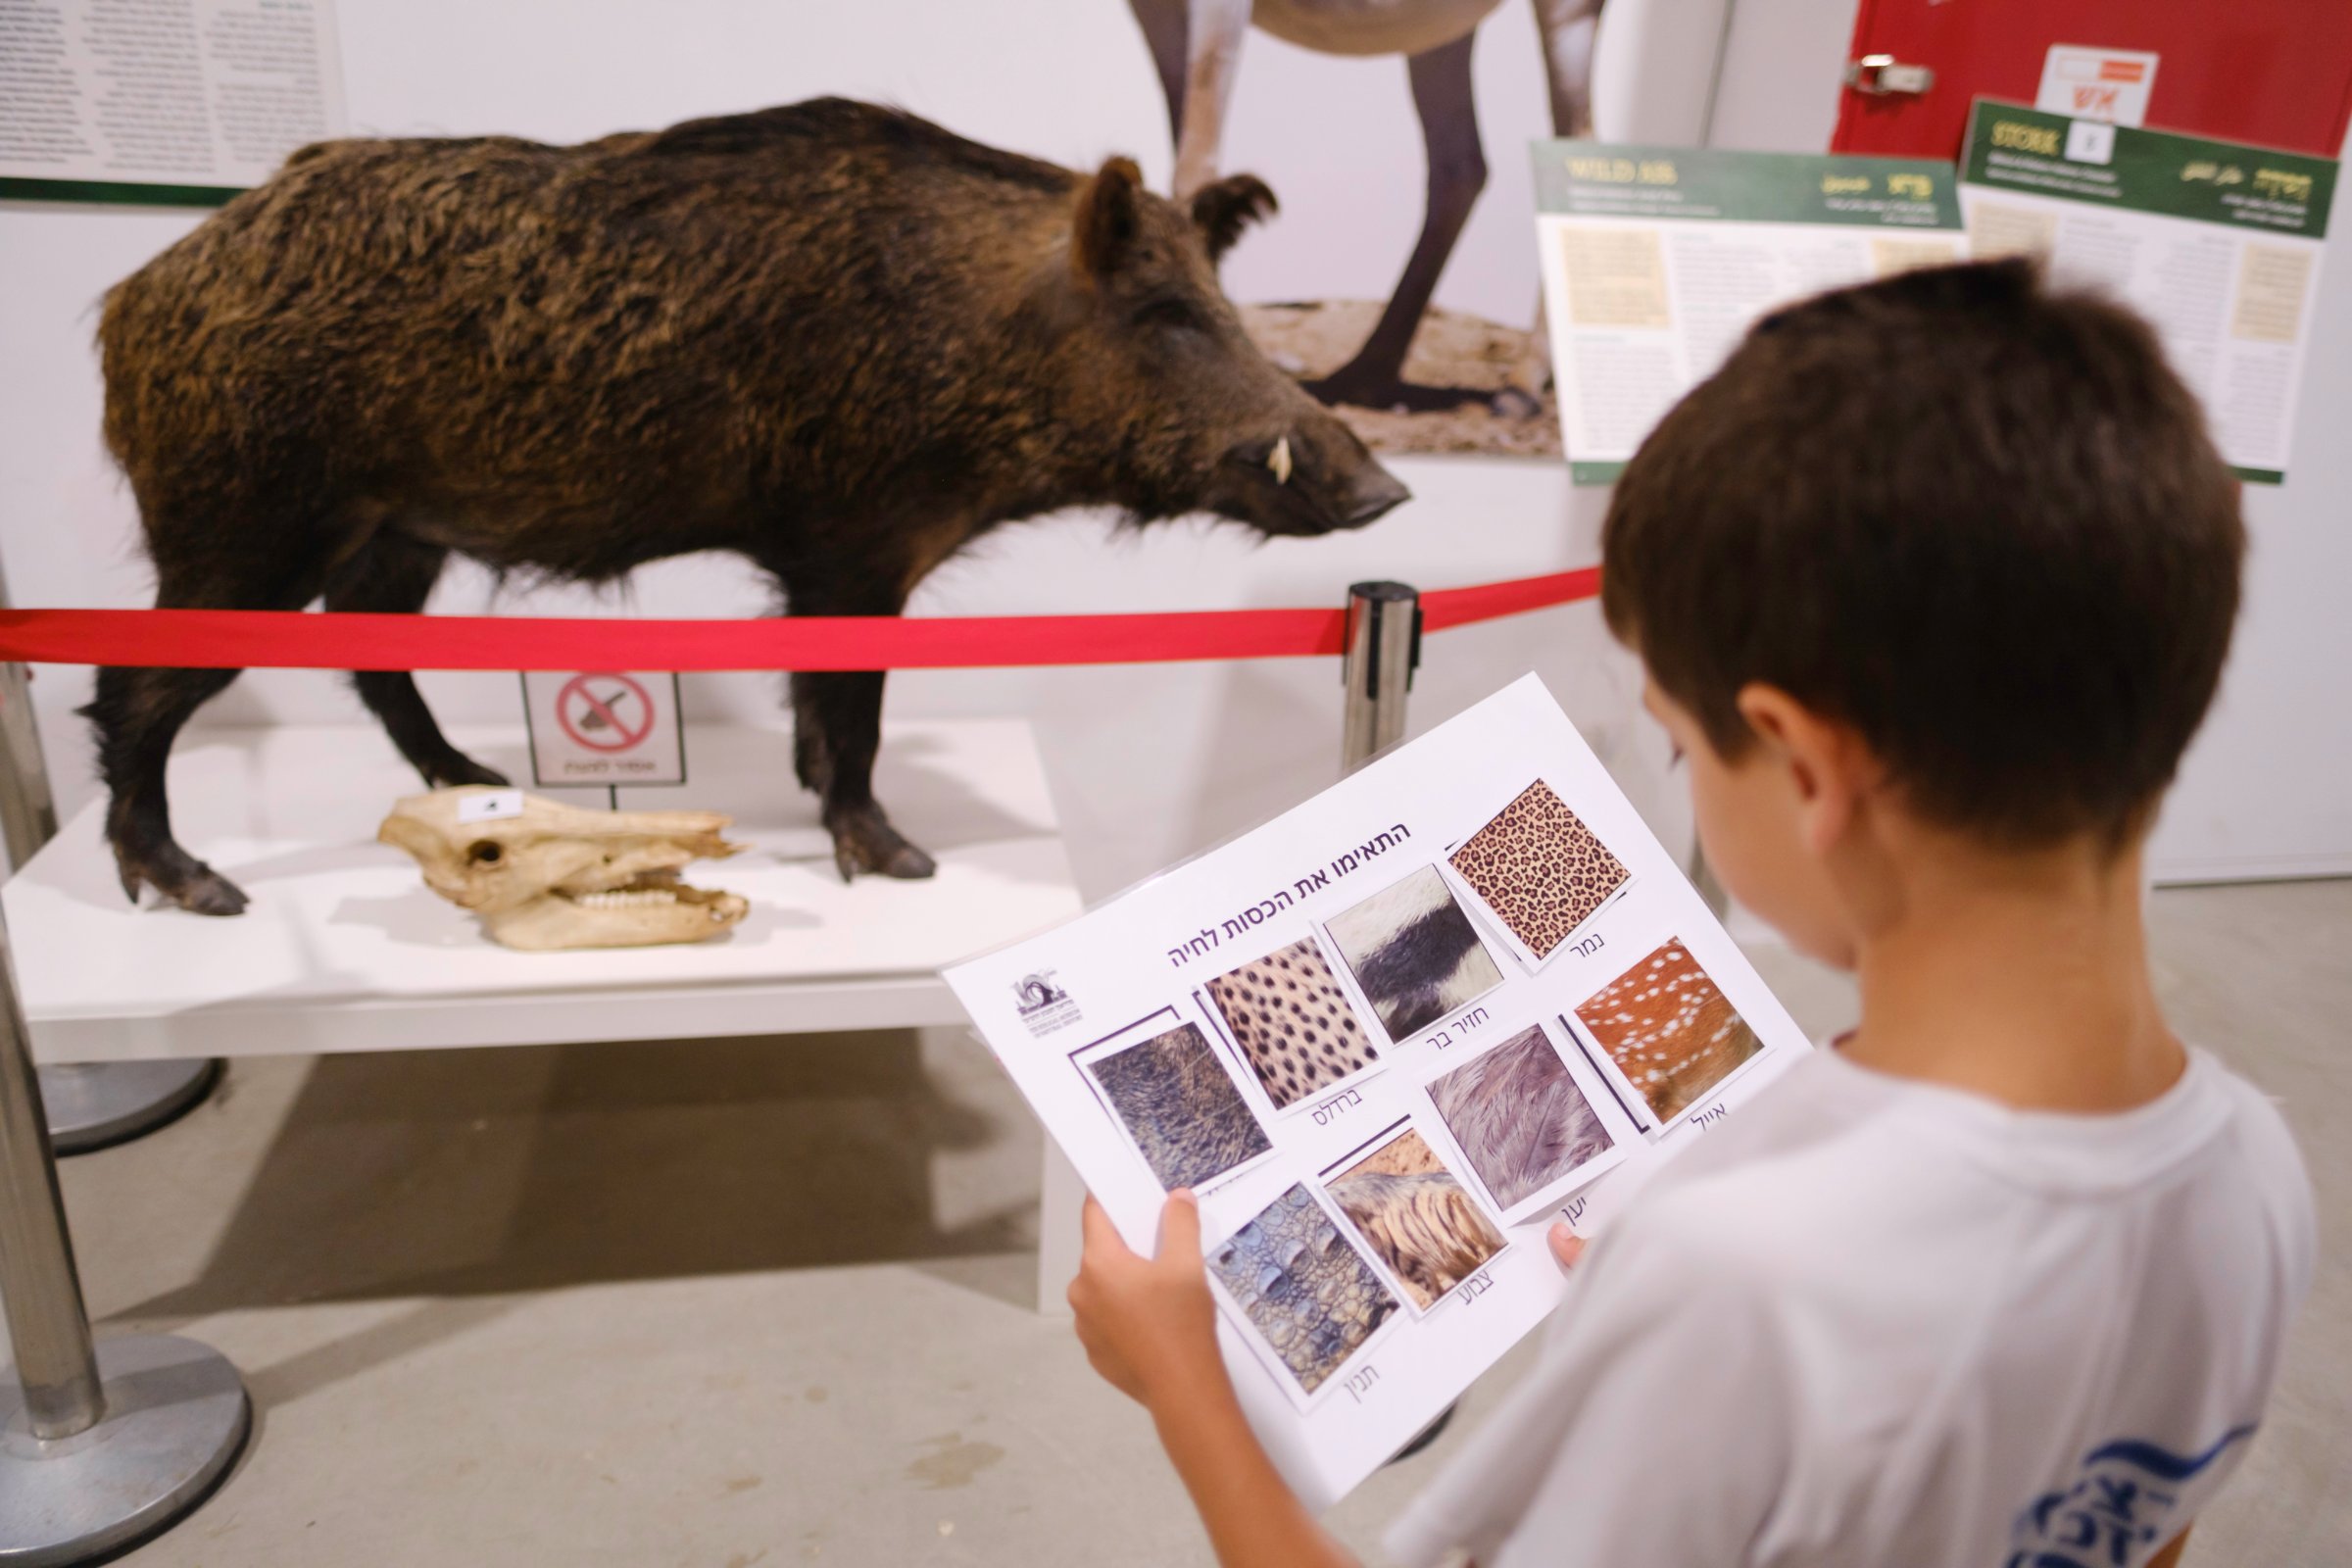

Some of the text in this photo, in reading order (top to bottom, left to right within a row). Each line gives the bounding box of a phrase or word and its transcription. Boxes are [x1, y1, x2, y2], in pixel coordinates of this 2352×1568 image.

[1991, 121, 2060, 156] STORK
[1564, 157, 1636, 183] WILD
[1167, 823, 1411, 967] התאימו את הכסות לחיה
[1569, 933, 1605, 957] נמר
[1426, 1006, 1490, 1051] חזיר בר
[1311, 1089, 1362, 1125] ברדלס
[1690, 1102, 1728, 1132] אייל
[1561, 1197, 1587, 1227] יען
[1456, 1269, 1494, 1305] צבוע
[1344, 1365, 1380, 1404] תנין
